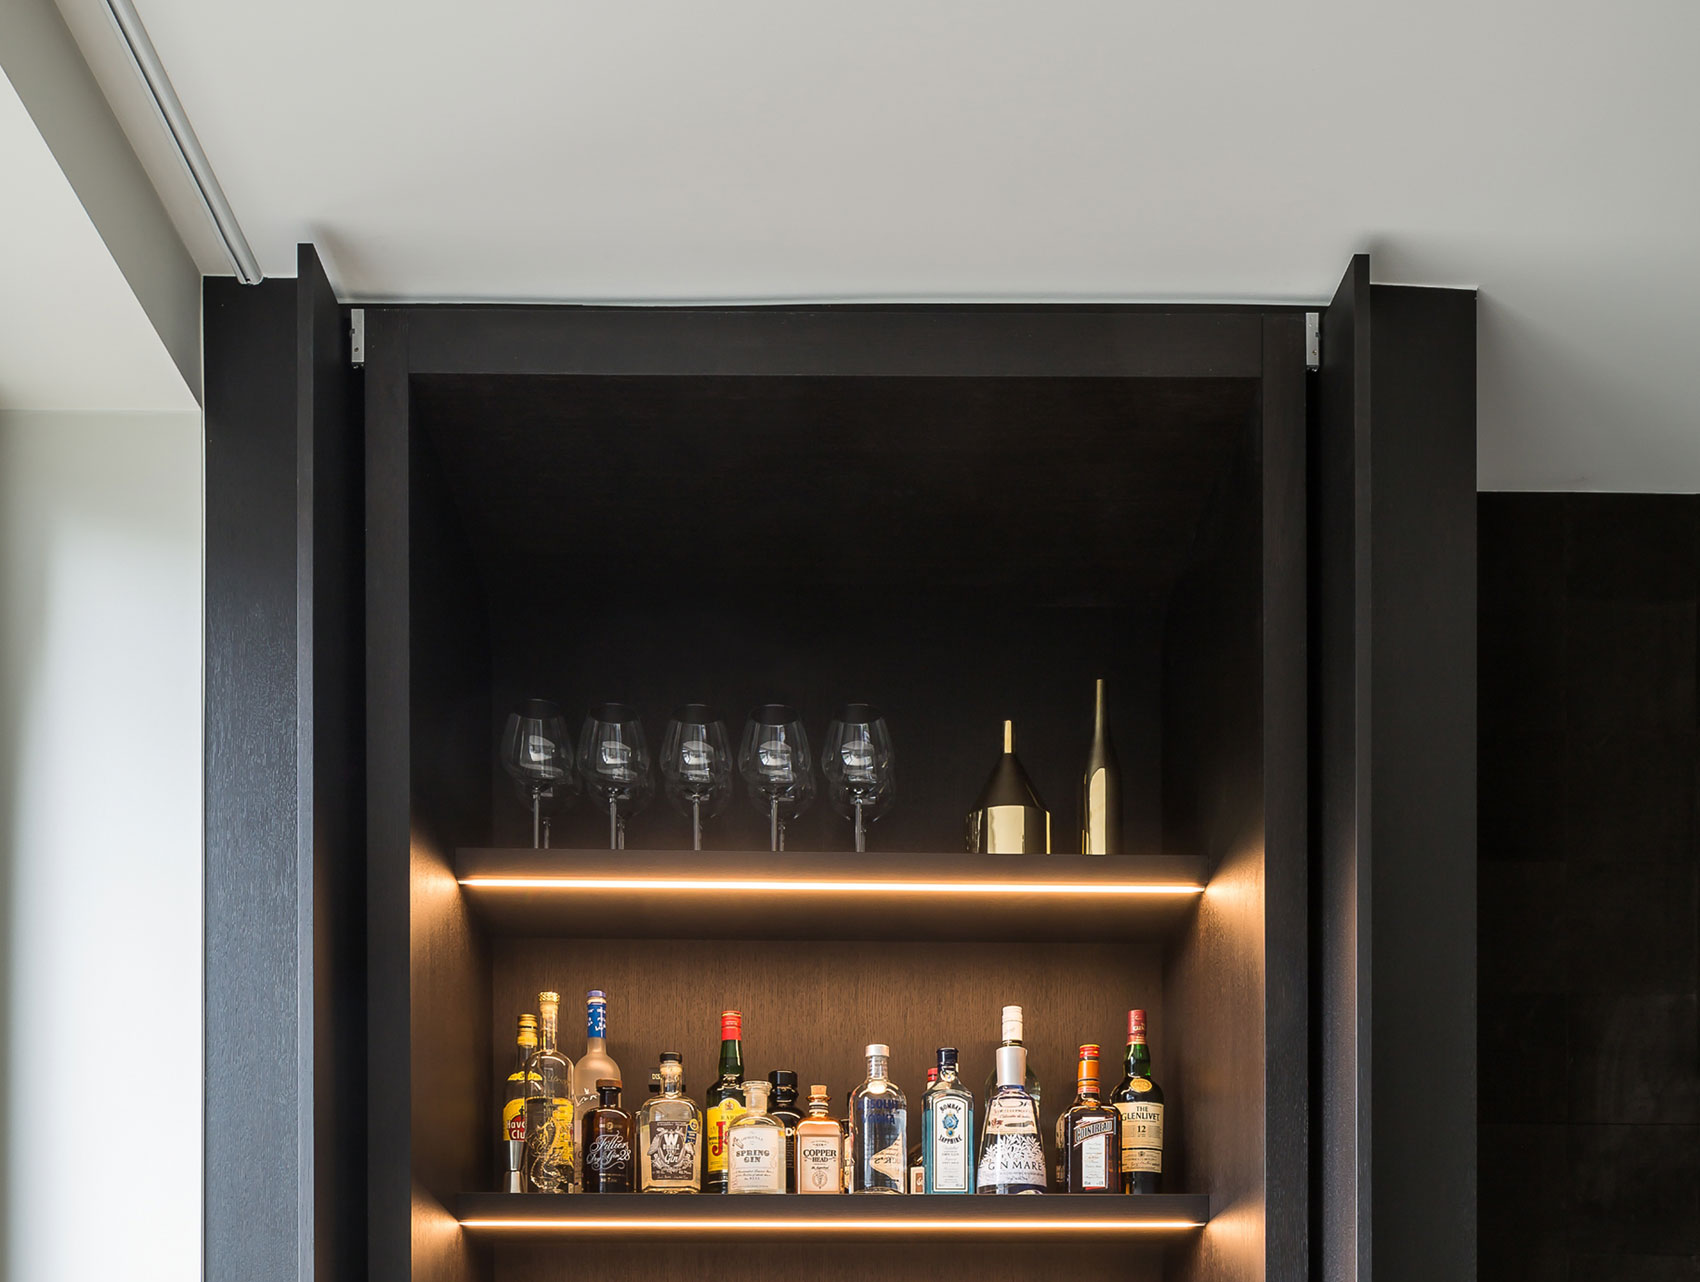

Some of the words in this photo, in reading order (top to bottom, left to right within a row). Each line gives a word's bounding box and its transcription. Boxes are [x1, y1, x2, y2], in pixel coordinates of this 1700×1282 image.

[940, 1103, 962, 1112] BOMBAY
[1122, 1112, 1160, 1121] GLENLIVET
[1075, 1120, 1112, 1142] COINTREAU
[1137, 1125, 1146, 1133] 12
[511, 1129, 526, 1140] Clu
[663, 1133, 679, 1146] W
[617, 1149, 631, 1161] 28
[736, 1149, 770, 1158] SPRING
[803, 1149, 837, 1157] COPPER
[988, 1161, 1008, 1170] GN
[1012, 1161, 1042, 1171] MARE
